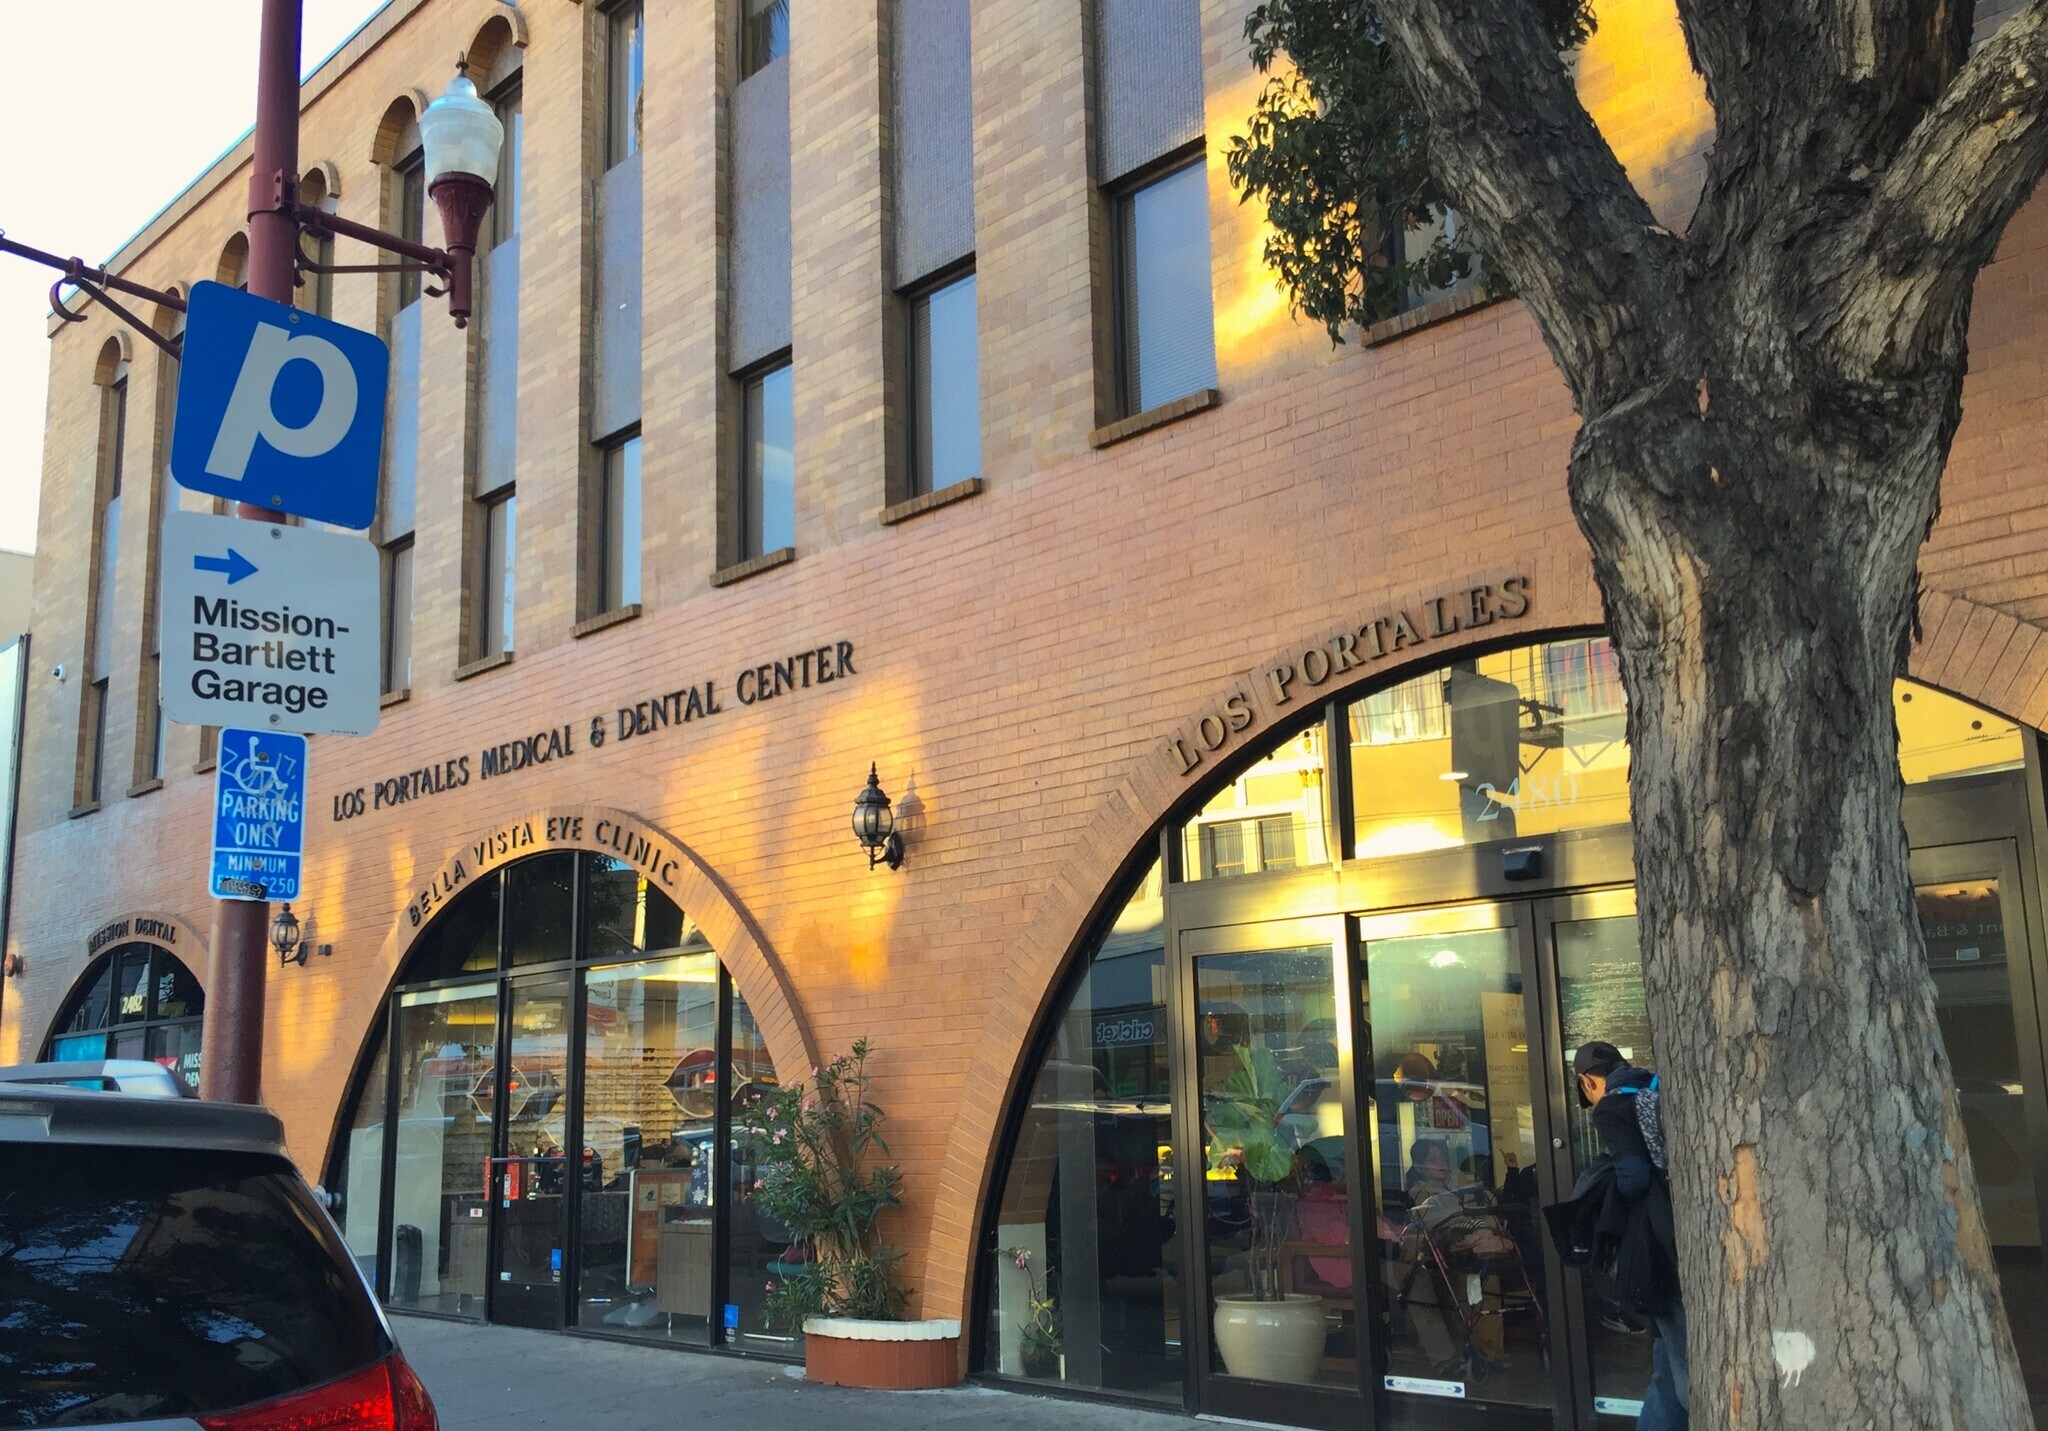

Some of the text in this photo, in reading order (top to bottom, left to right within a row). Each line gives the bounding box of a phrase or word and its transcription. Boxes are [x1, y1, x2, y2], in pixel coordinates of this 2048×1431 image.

[193, 595, 349, 640] Mission-
[193, 632, 336, 675] Bartlett
[191, 669, 328, 714] Garage
[1165, 577, 1532, 776] LOS PORTALES
[333, 640, 857, 821] LOS PORTALES MEDICAL & DENTAL CENTER
[221, 794, 300, 824] PARKING
[1475, 771, 1579, 822] 2480
[234, 822, 284, 848] ONLY
[228, 854, 287, 873] MINMUM
[408, 816, 680, 927] BELLA VISTA EYE CLINIC
[88, 918, 176, 956] MISSION DENTAL
[1435, 1110, 1461, 1129] OPEN
